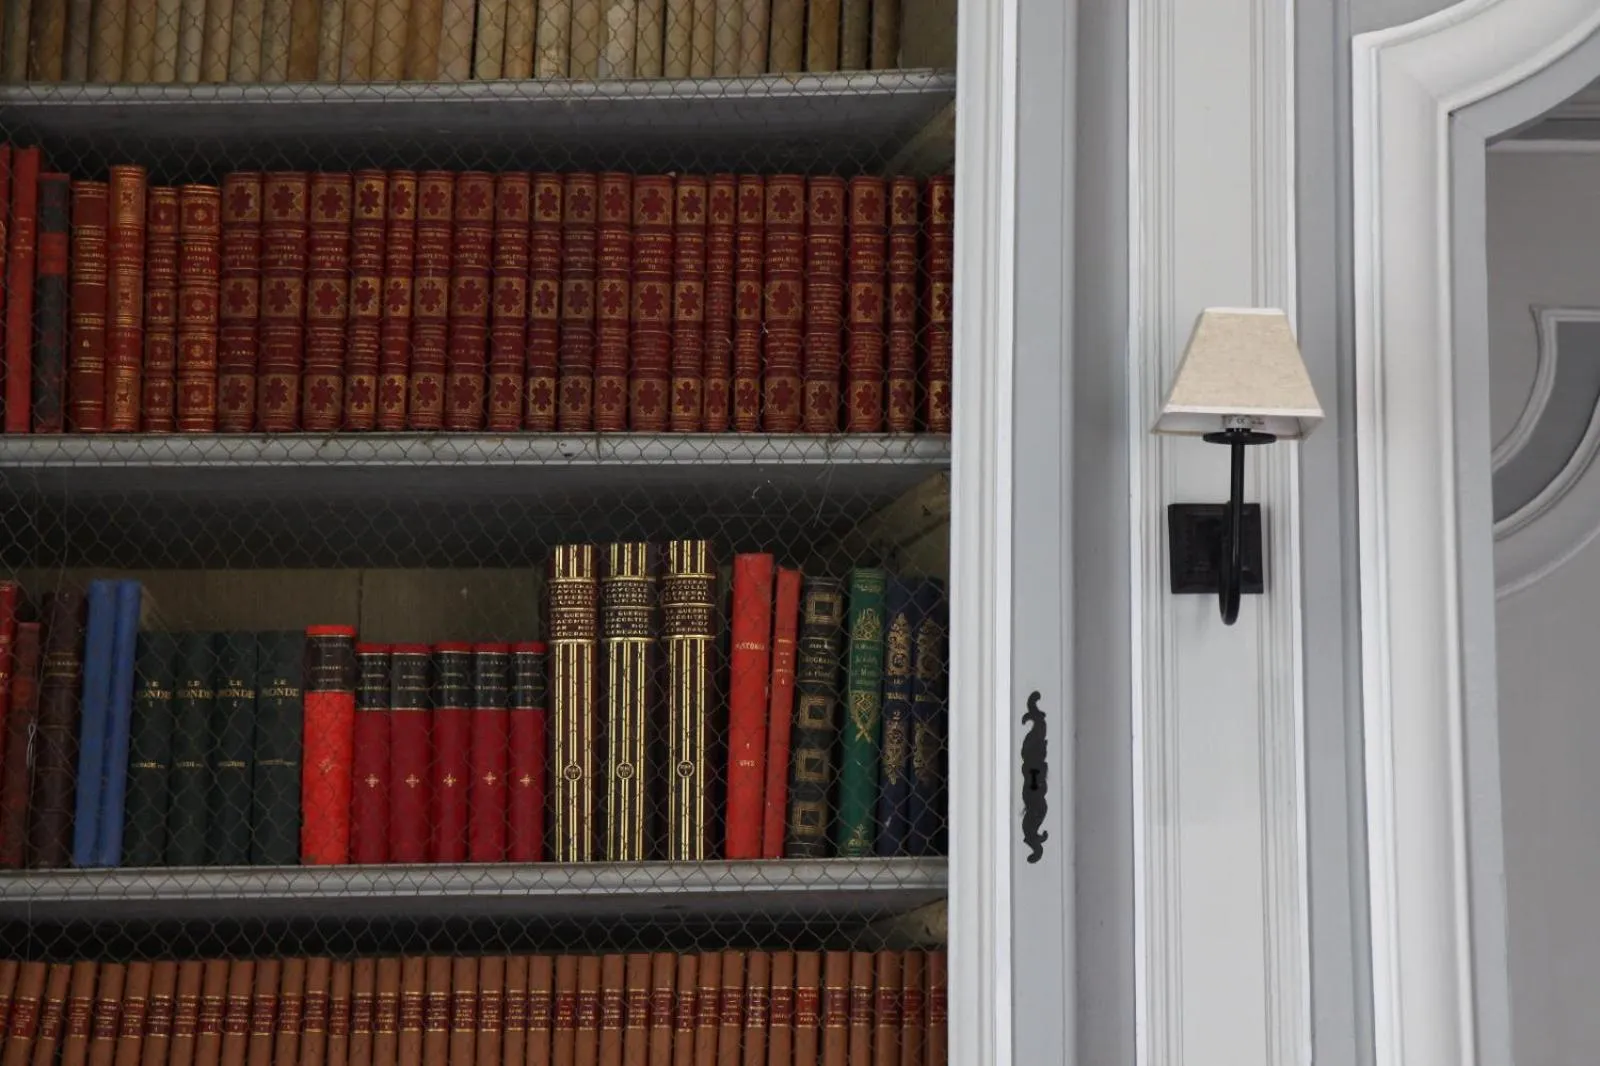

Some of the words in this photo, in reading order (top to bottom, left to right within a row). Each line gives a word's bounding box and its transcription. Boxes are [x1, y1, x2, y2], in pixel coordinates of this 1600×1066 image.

[227, 679, 243, 687] LE
[137, 688, 173, 699] ONDE
[178, 687, 211, 698] ONDE
